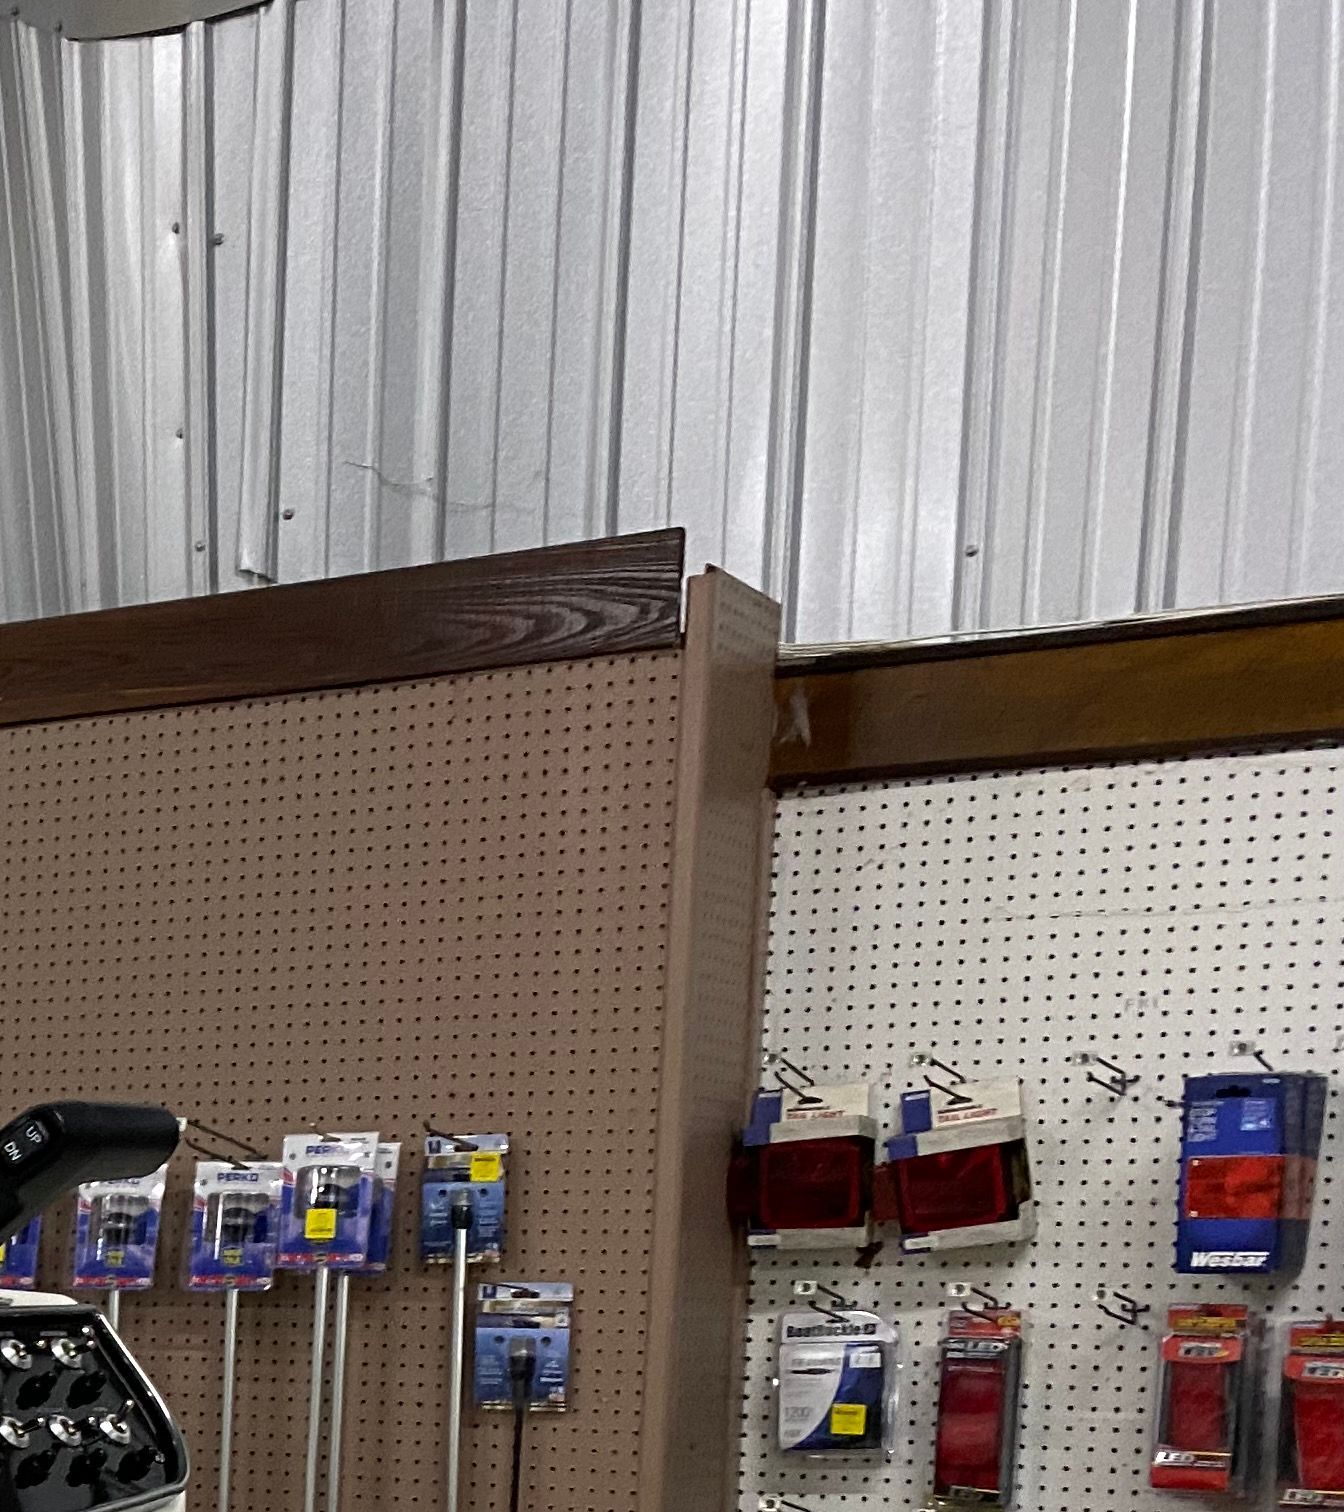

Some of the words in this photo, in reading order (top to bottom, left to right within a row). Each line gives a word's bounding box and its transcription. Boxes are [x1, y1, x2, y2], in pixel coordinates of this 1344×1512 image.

[25, 1125, 42, 1143] UP
[3, 1141, 22, 1161] DN
[217, 1172, 259, 1182] PERKO
[1190, 1252, 1270, 1268] Wesbar
